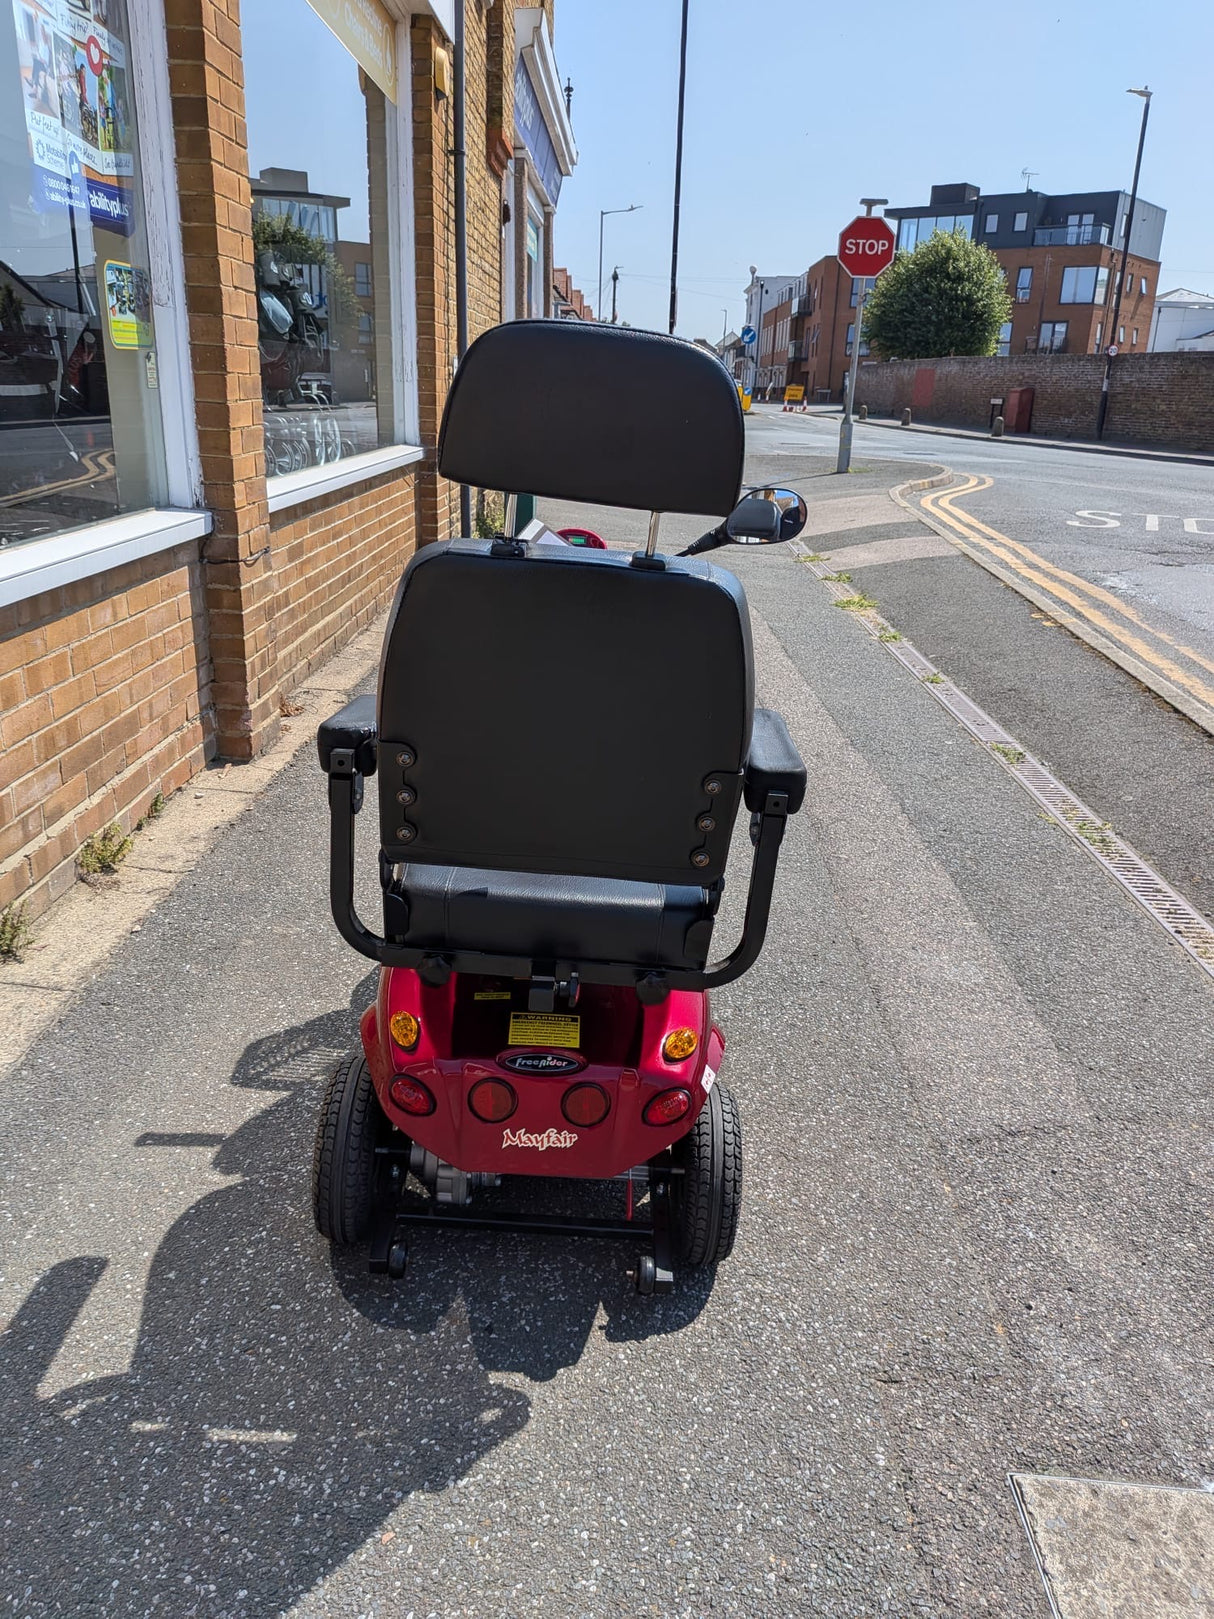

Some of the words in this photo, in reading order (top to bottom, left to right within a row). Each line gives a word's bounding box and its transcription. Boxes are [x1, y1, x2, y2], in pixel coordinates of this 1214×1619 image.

[89, 190, 129, 218] abilityplus
[845, 238, 889, 255] STOP
[502, 1128, 578, 1151] Mayfair
